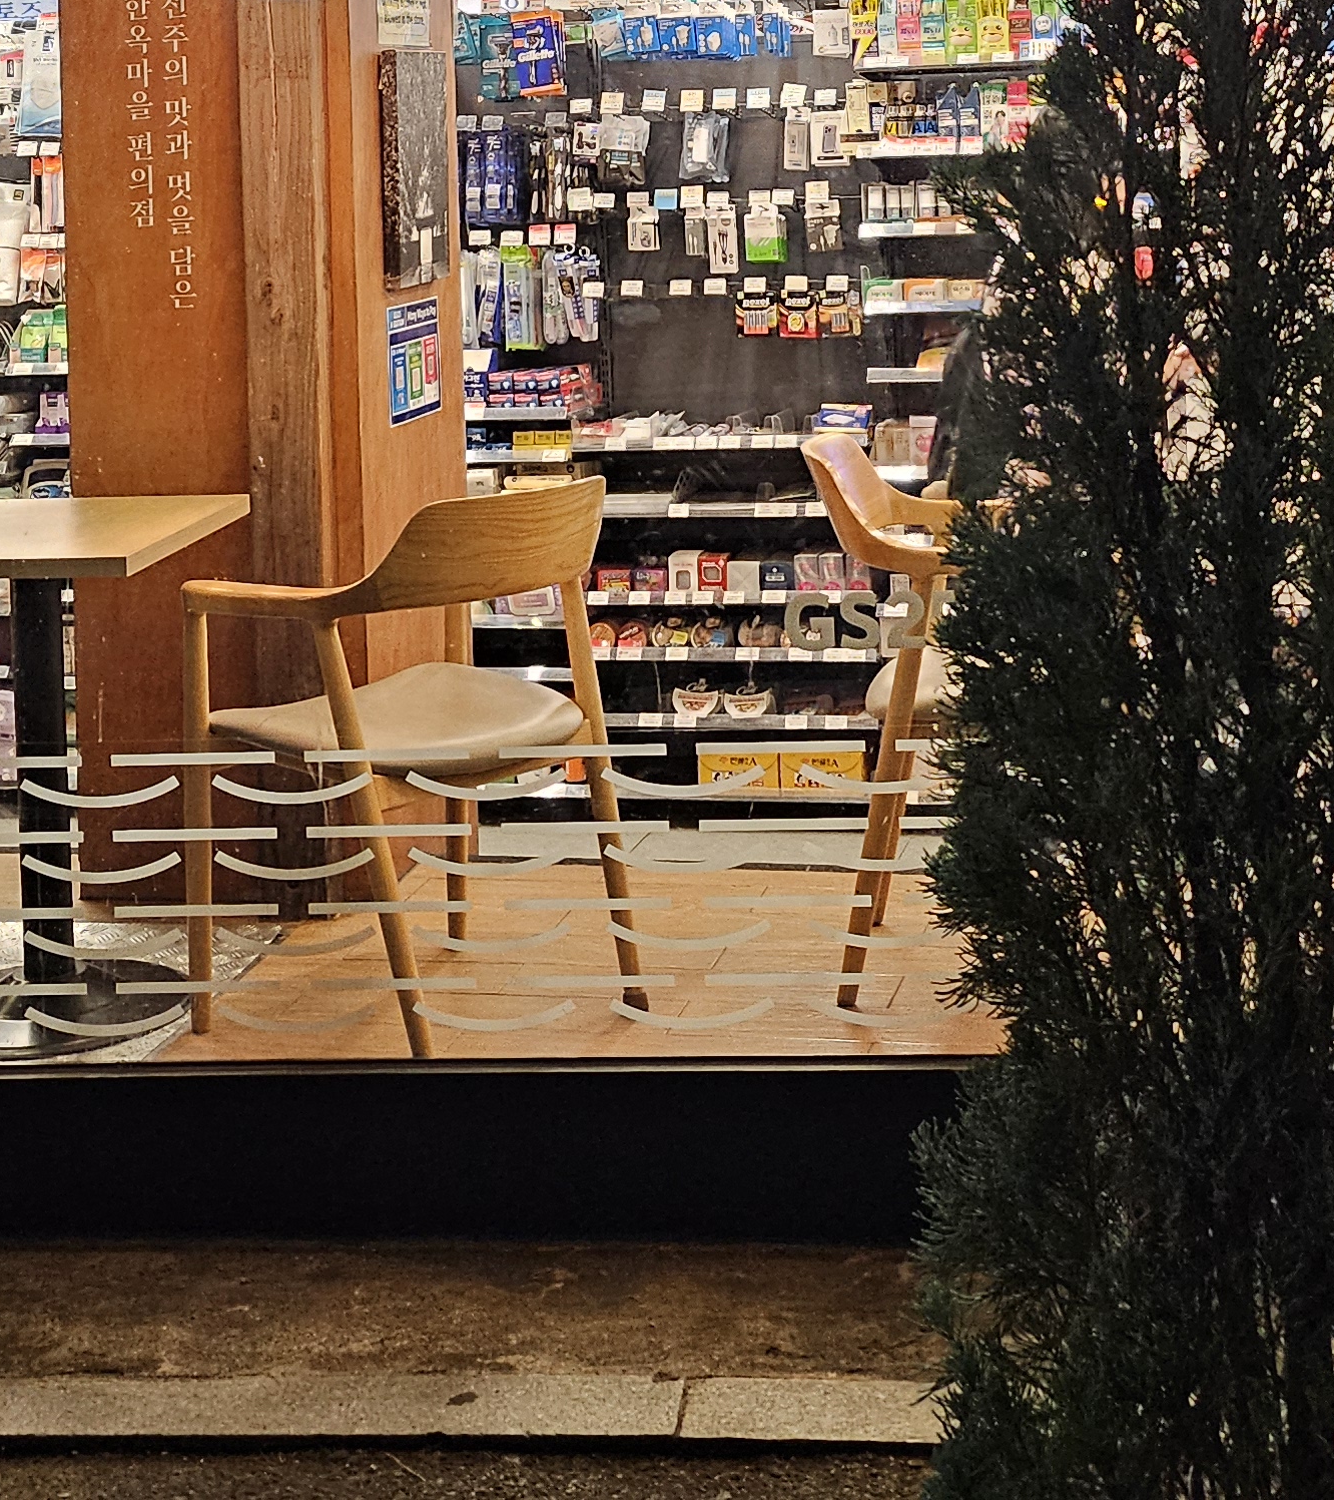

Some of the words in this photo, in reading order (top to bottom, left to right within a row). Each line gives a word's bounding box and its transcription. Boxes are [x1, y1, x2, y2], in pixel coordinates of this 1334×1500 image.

[518, 49, 555, 63] Gillette
[163, 96, 193, 161] 맛과
[126, 133, 155, 229] 편의점
[166, 172, 196, 235] 멋을
[169, 247, 198, 310] 담은
